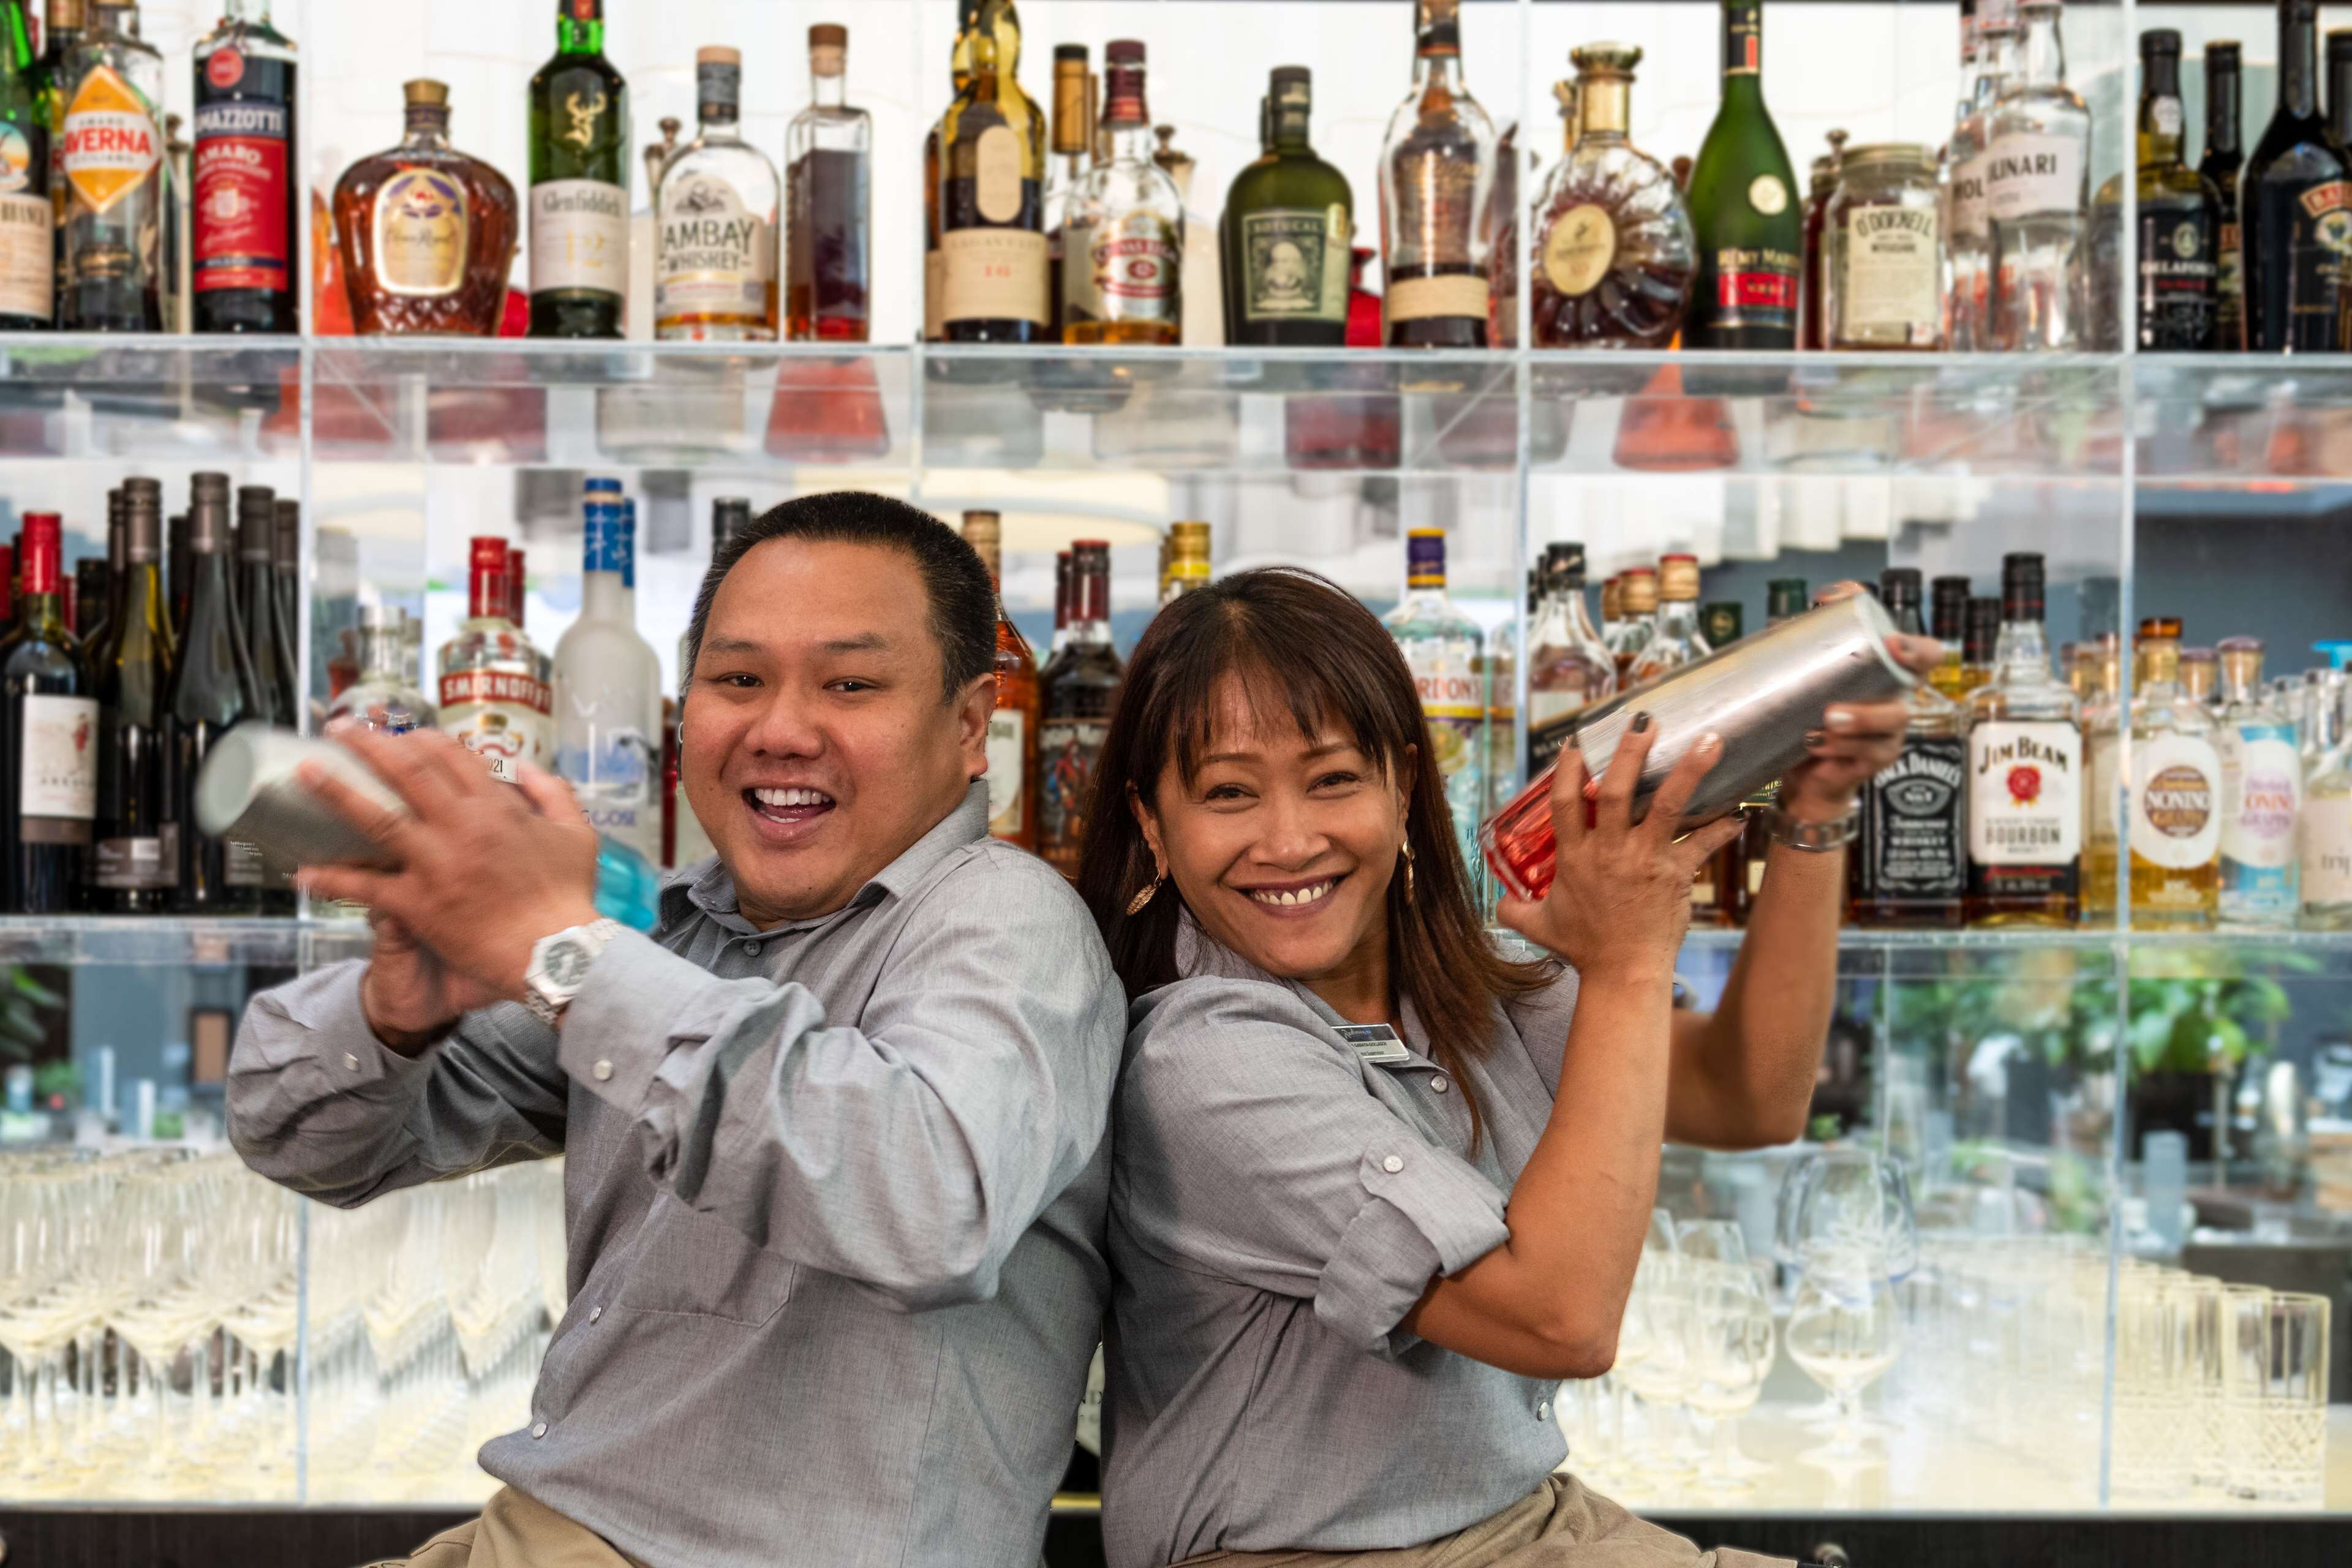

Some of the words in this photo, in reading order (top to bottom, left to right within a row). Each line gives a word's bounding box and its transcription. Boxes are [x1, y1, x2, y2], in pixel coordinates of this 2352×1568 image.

[198, 143, 262, 165] AMARO
[669, 252, 740, 271] WHISKEY
[1978, 744, 2013, 774] JIM
[2018, 736, 2068, 772] BEAM
[1985, 827, 2061, 844] BOURBON
